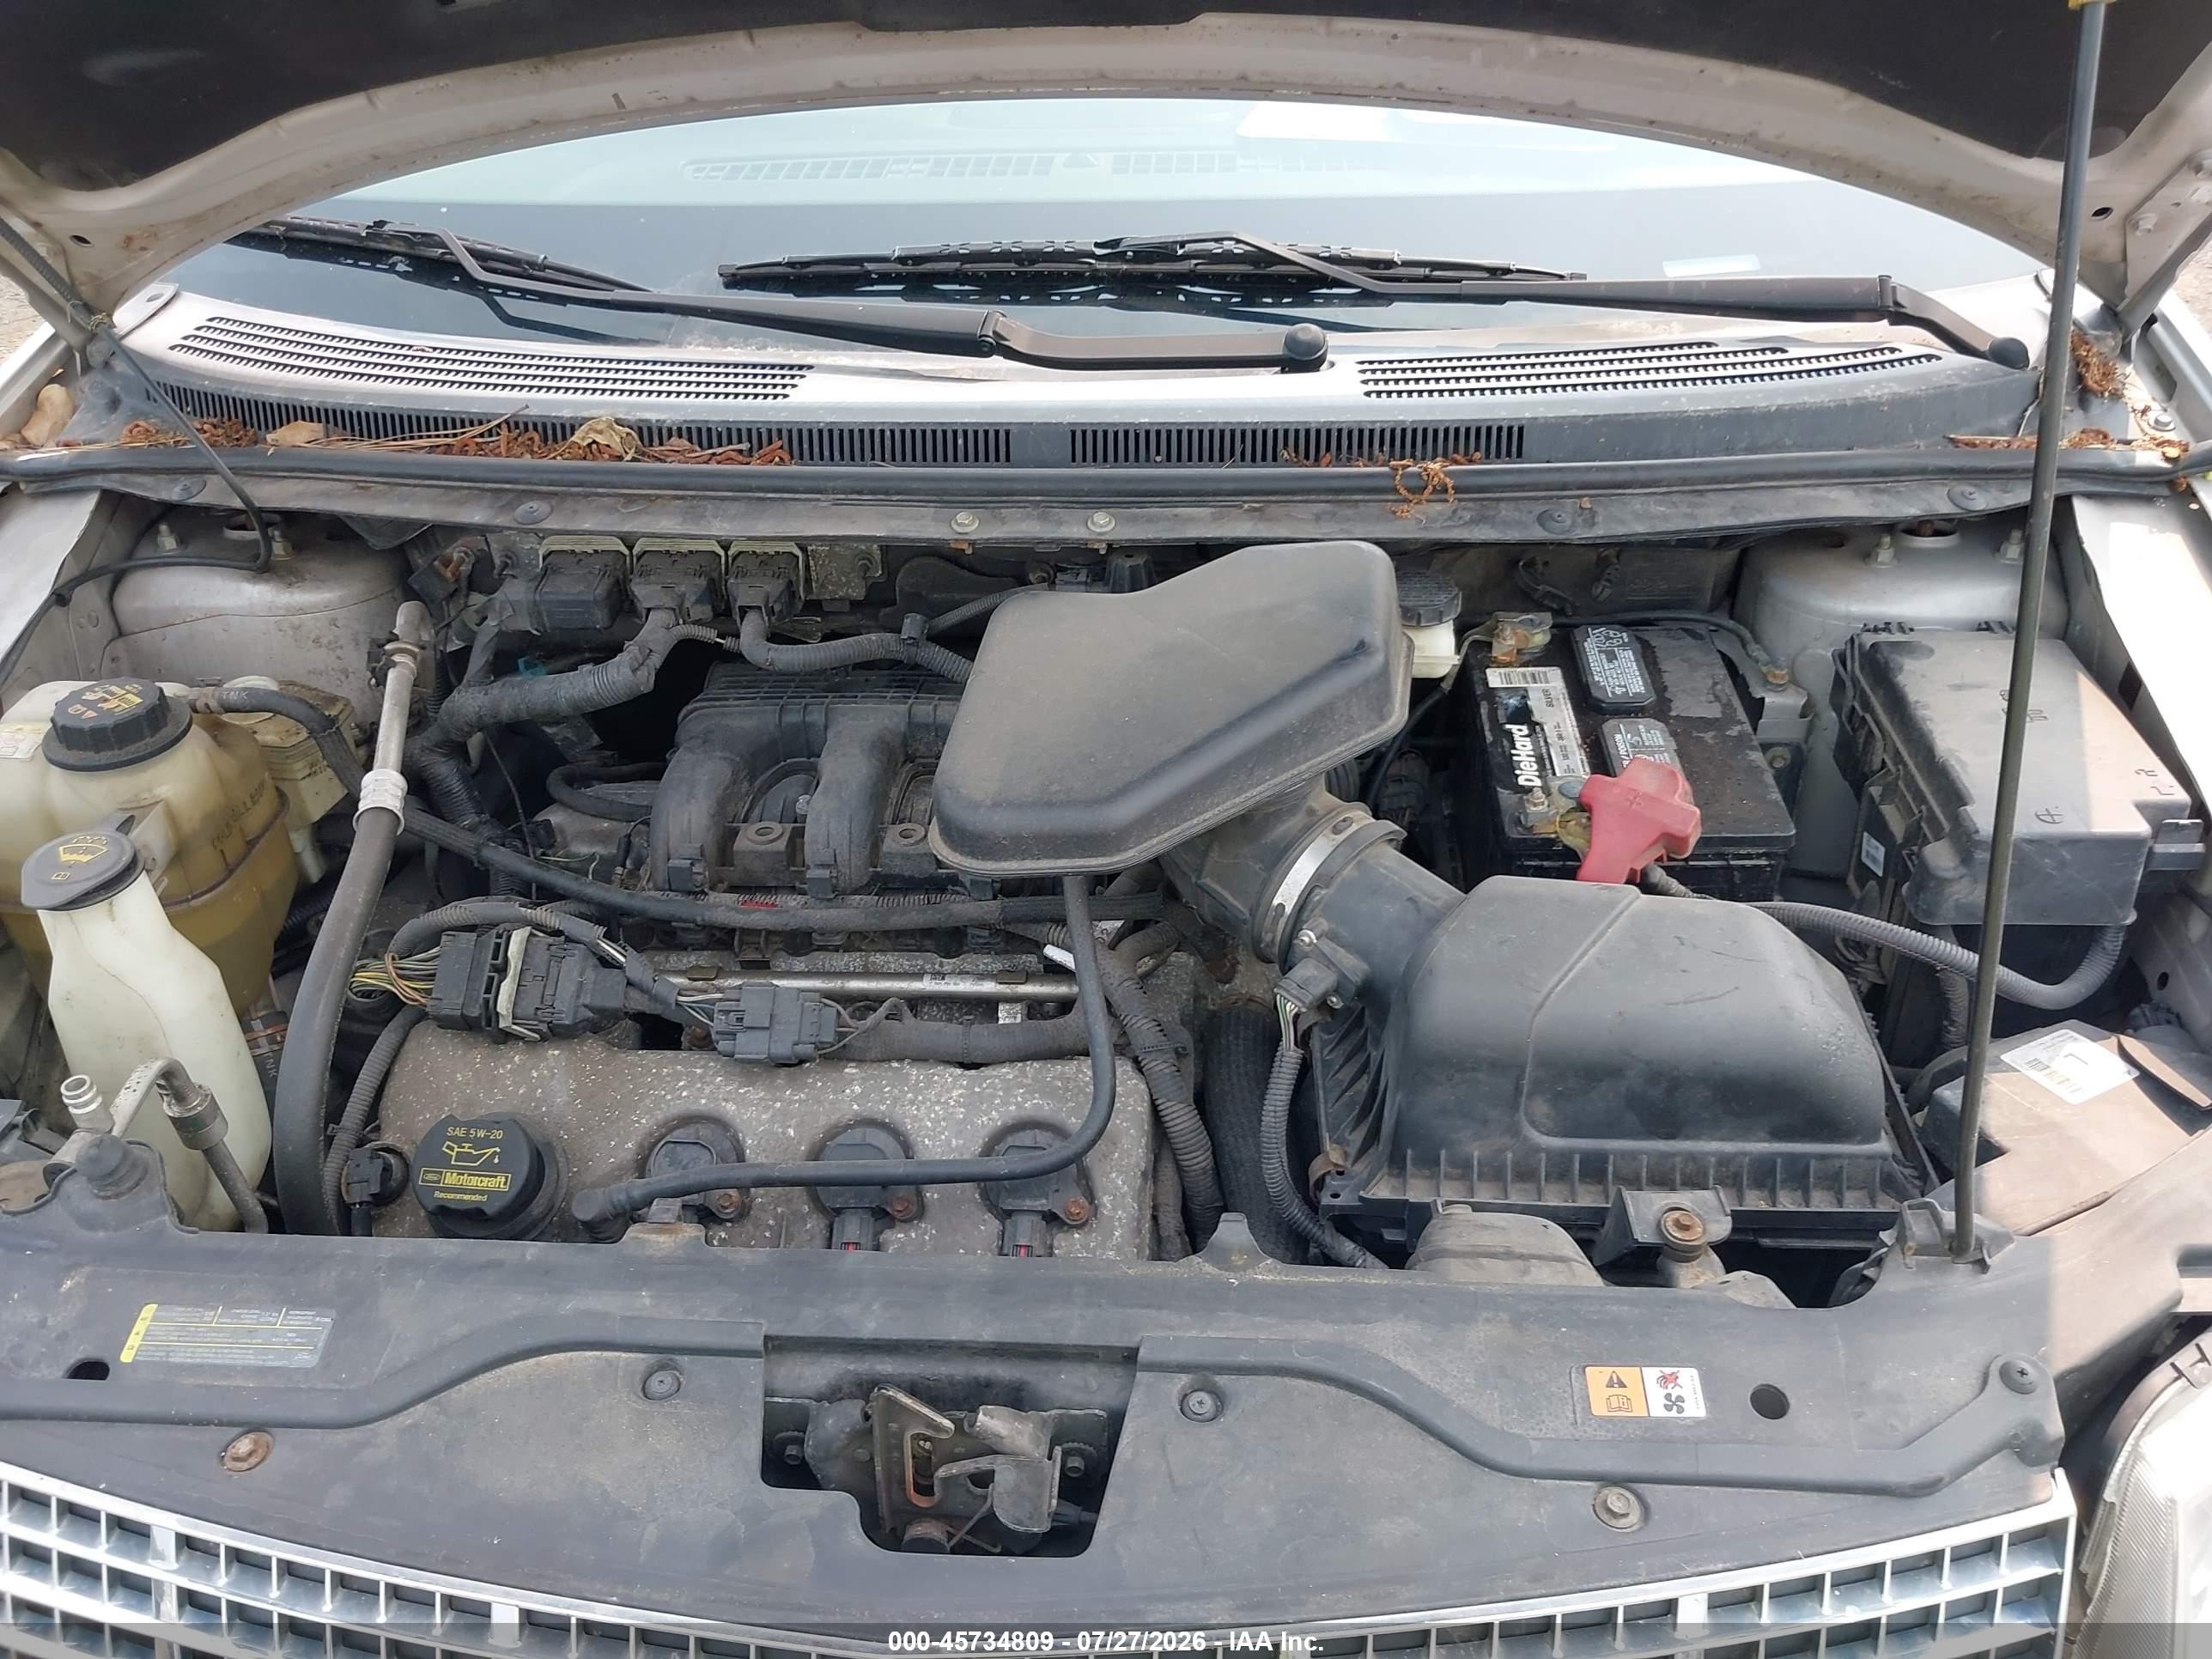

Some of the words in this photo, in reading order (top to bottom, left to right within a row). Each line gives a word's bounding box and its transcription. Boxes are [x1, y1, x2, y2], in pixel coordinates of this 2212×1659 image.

[1541, 688, 1555, 708] SILVER
[1504, 723, 1542, 787] DieHard
[446, 1127, 468, 1137] SAE
[469, 1127, 503, 1139] 5W-20
[444, 1171, 507, 1188] Motorcraft
[433, 1190, 488, 1202] Recommended
